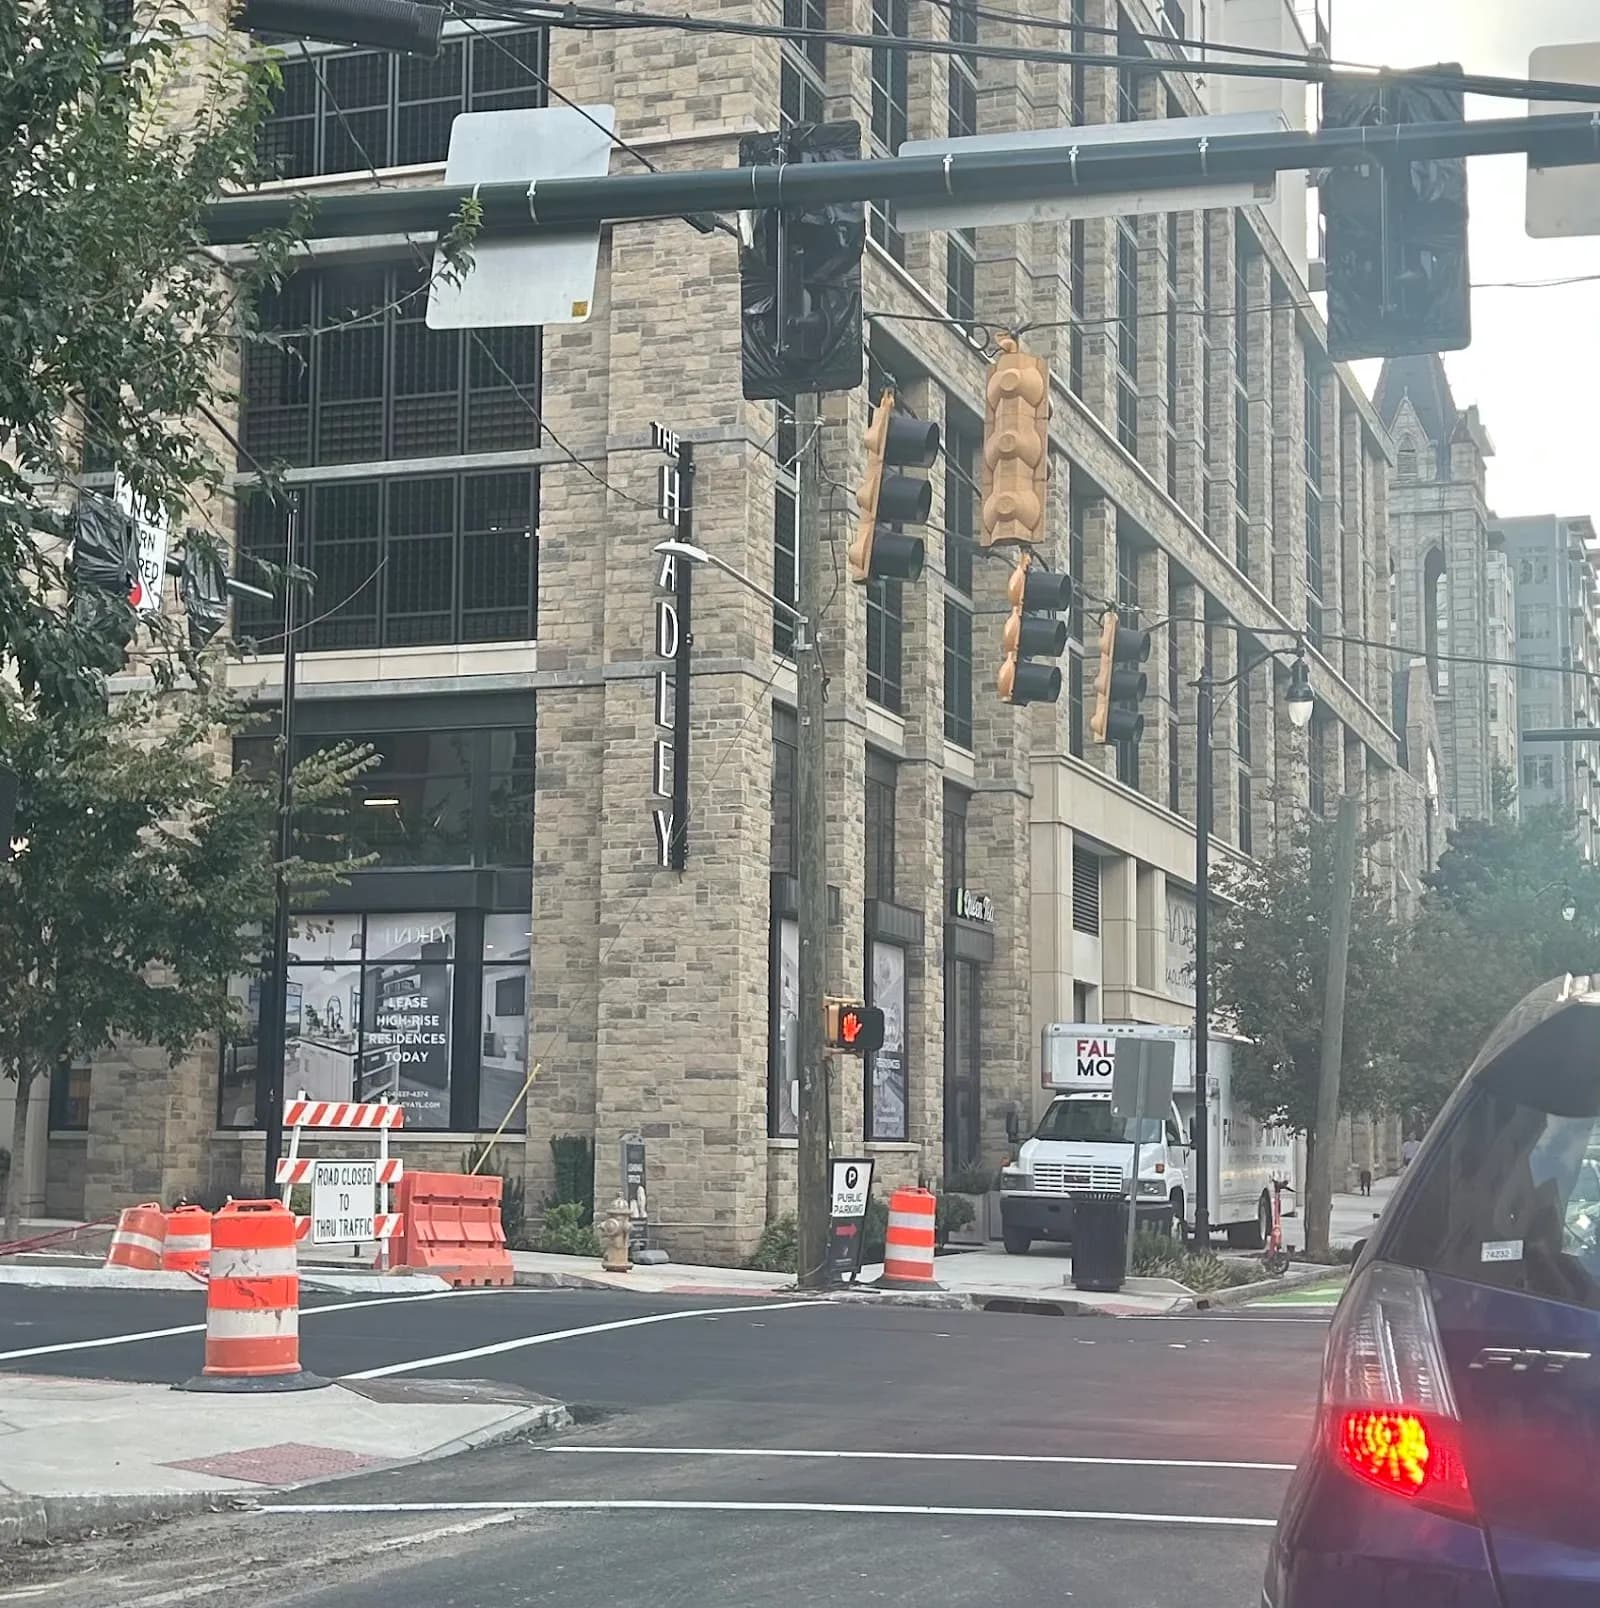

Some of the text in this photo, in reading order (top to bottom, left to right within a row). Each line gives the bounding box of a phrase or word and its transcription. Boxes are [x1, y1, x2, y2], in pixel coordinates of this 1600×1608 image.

[653, 420, 680, 458] THE
[654, 465, 680, 867] HADLEY
[388, 997, 428, 1009] LEASE
[376, 1014, 440, 1026] HIGH-RISE
[368, 1033, 446, 1045] RESIDENCES
[384, 1051, 429, 1062] TODAY
[1077, 1040, 1115, 1058] FAL
[1077, 1058, 1113, 1077] MO
[317, 1168, 373, 1185] ROAD CLOSED
[339, 1193, 350, 1211] TO
[837, 1193, 862, 1203] PUBLIC
[834, 1204, 865, 1214] PARKING
[316, 1217, 373, 1237] THRU TRAFFIC
